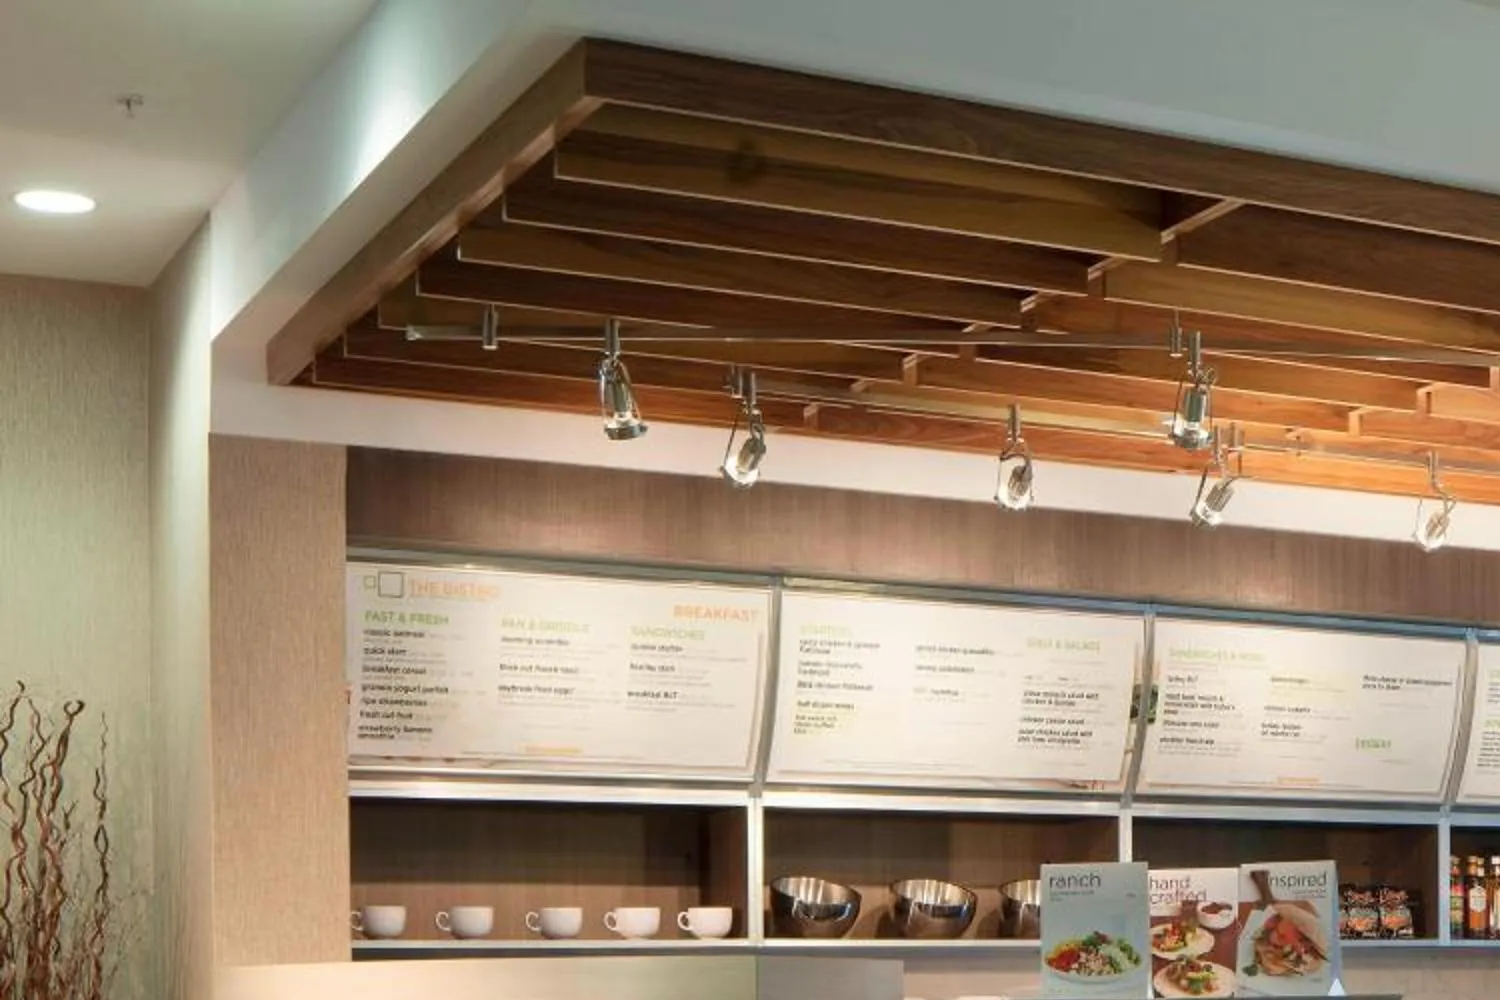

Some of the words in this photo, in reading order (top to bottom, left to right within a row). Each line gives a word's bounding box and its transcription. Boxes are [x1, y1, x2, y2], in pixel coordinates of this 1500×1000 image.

[365, 610, 394, 622] FAST
[410, 612, 449, 625] FRESH
[674, 604, 758, 622] BREAKFAST
[1049, 872, 1101, 889] ranch
[1149, 874, 1190, 889] hand
[1266, 870, 1327, 888] inspired
[1149, 887, 1207, 905] crafted
